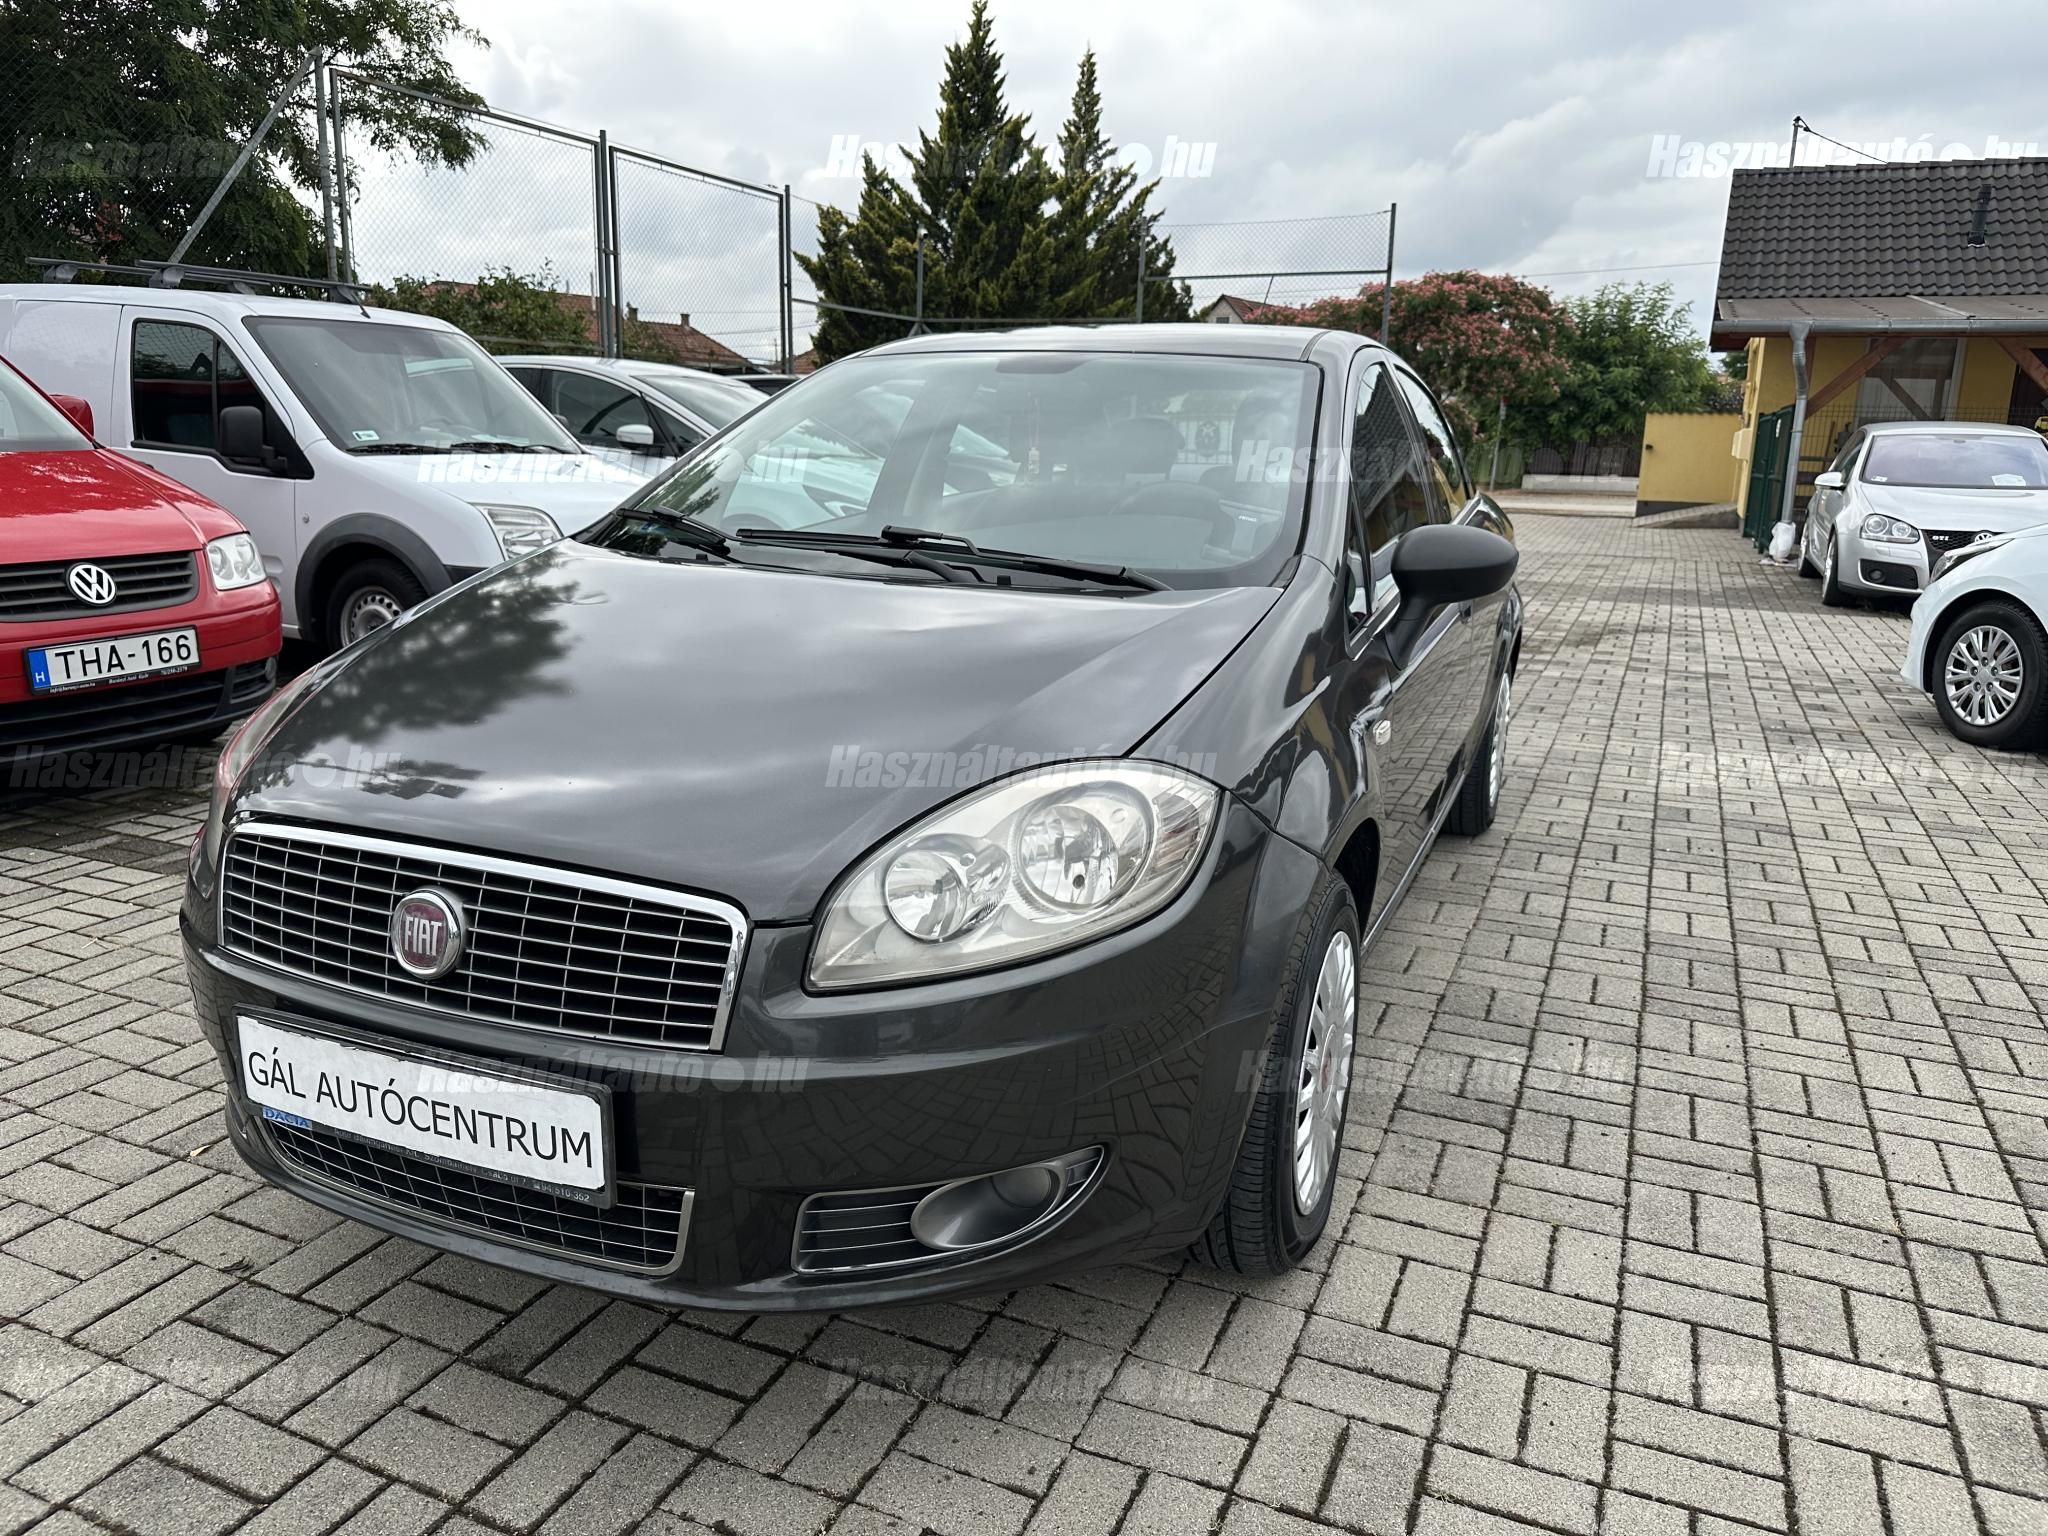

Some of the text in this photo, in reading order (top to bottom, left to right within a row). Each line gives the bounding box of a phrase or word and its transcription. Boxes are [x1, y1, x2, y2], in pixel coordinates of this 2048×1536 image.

[35, 672, 45, 683] H
[55, 635, 191, 679] THA-166
[405, 916, 442, 957] FIAT
[249, 1047, 593, 1168] GÁL AUTÓCENTRUM
[265, 1109, 309, 1128] DACIA
